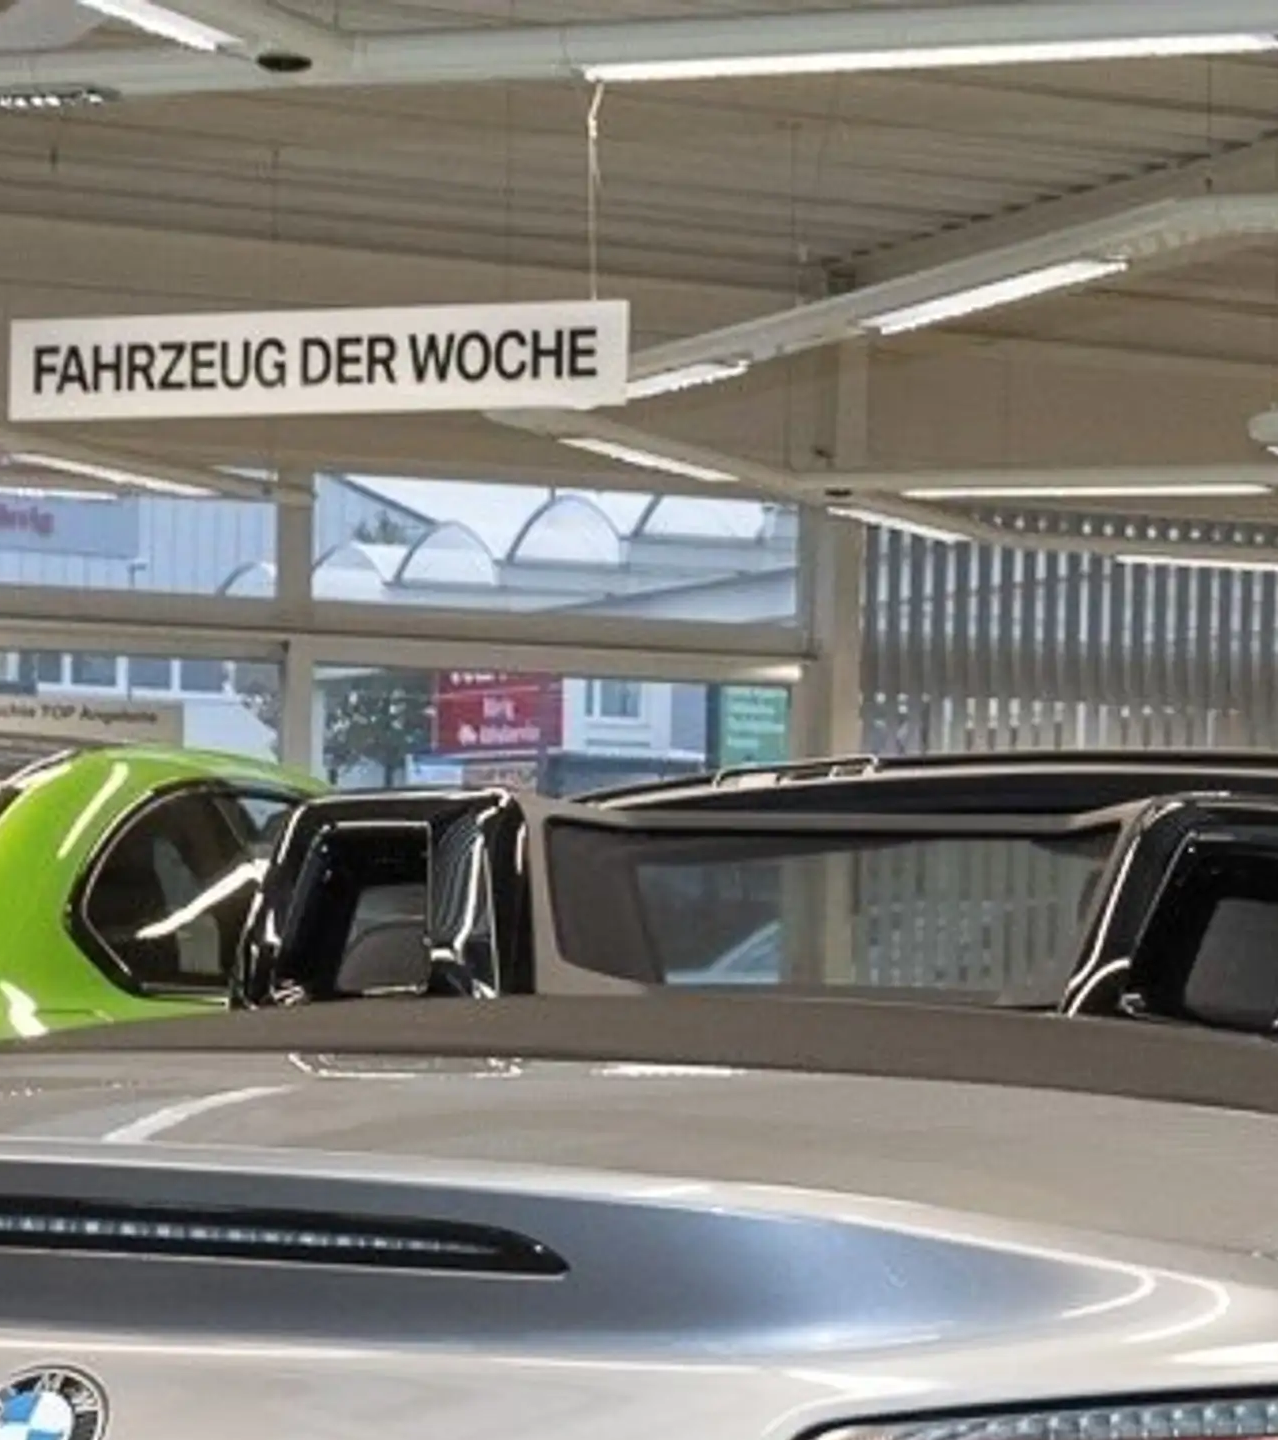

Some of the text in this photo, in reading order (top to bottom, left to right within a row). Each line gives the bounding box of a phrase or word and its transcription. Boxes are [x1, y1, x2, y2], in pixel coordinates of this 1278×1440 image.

[32, 327, 599, 395] FAHRZEUG DER WOCHE
